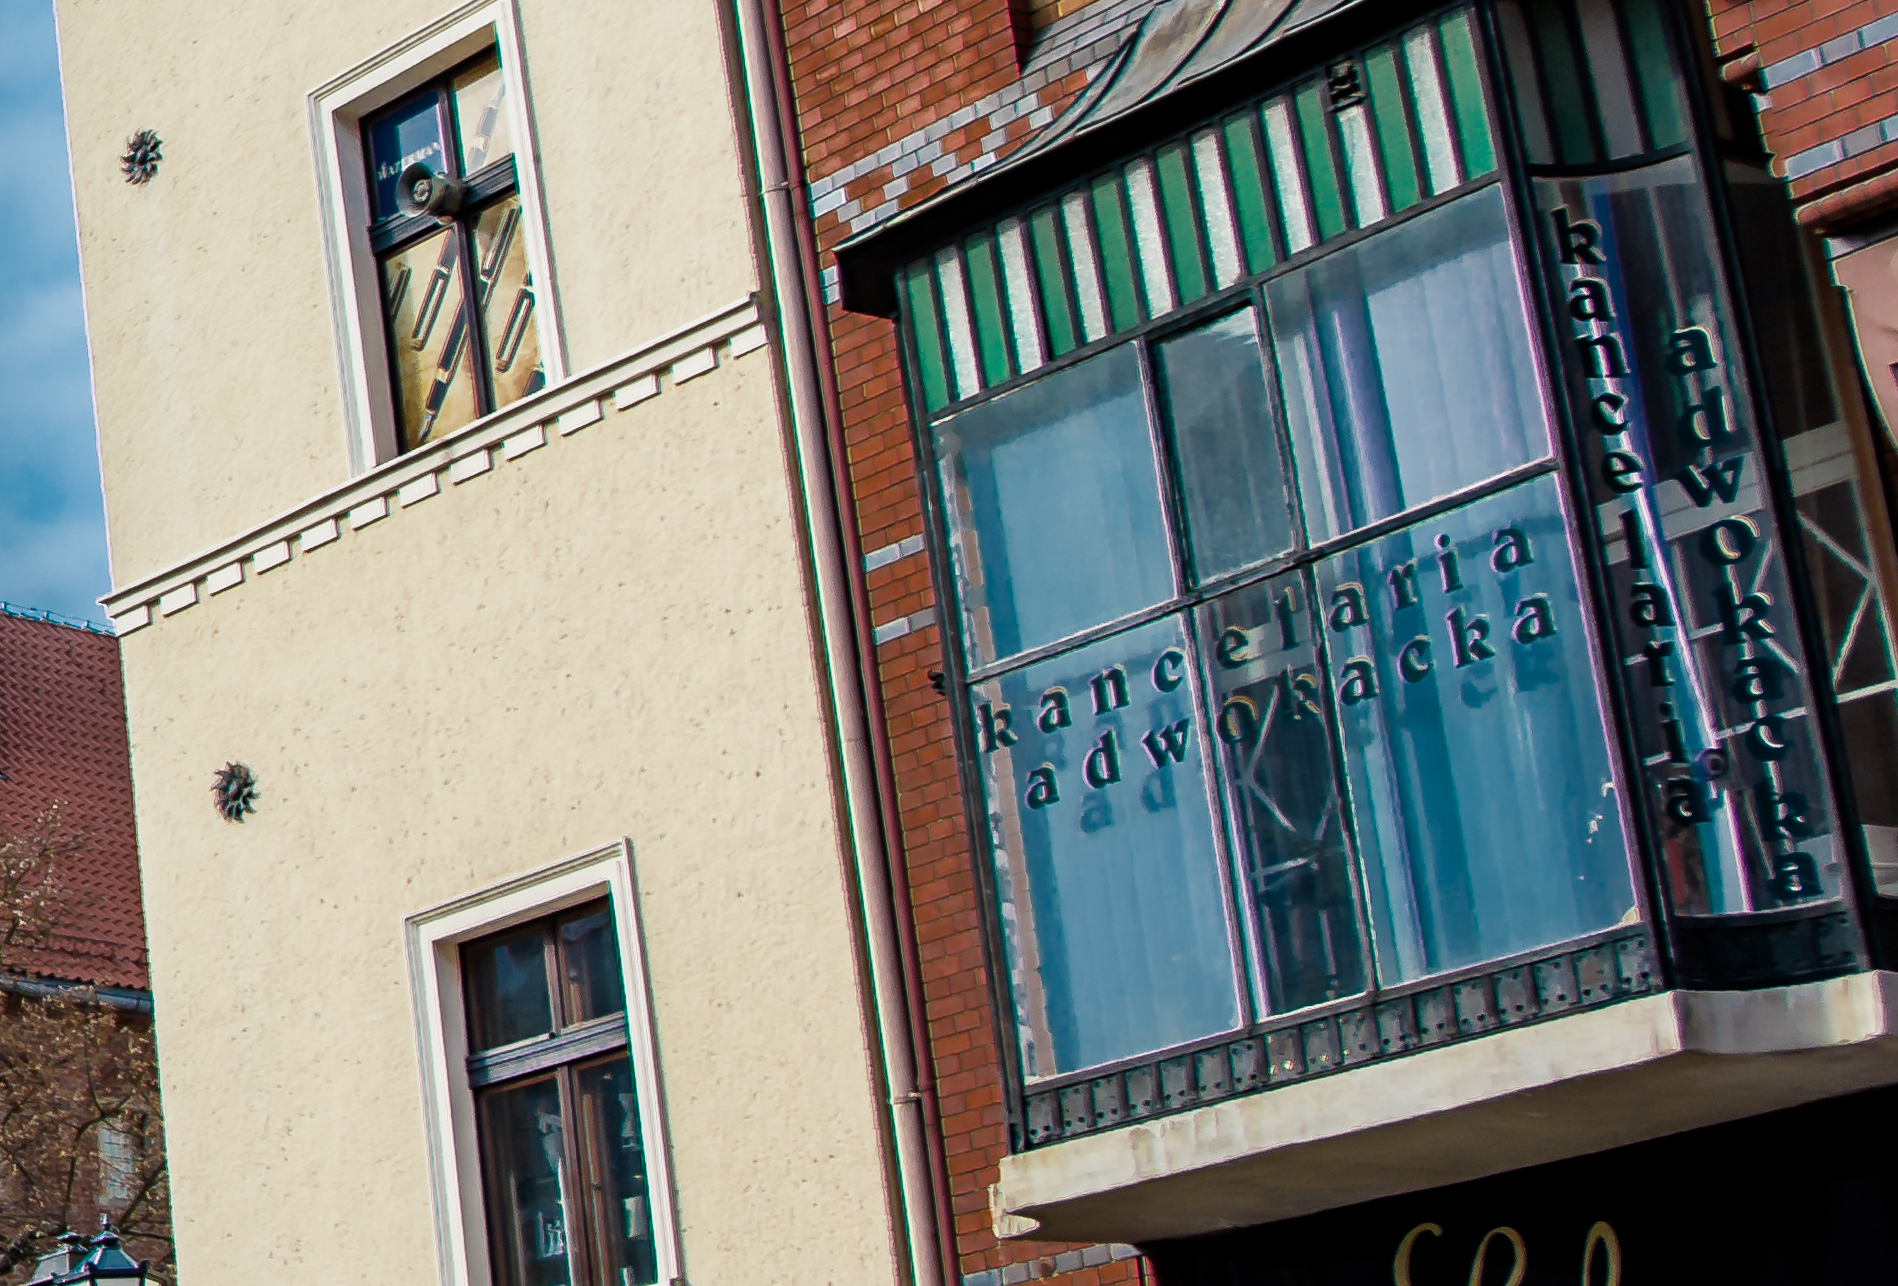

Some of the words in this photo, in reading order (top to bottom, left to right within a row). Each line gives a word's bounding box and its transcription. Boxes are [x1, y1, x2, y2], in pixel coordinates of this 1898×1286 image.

[977, 519, 1535, 755] kancelaria
[1024, 589, 1559, 813] adwokacka
[1553, 204, 1714, 829] kancelaria
[1665, 320, 1824, 903] adwokacka
